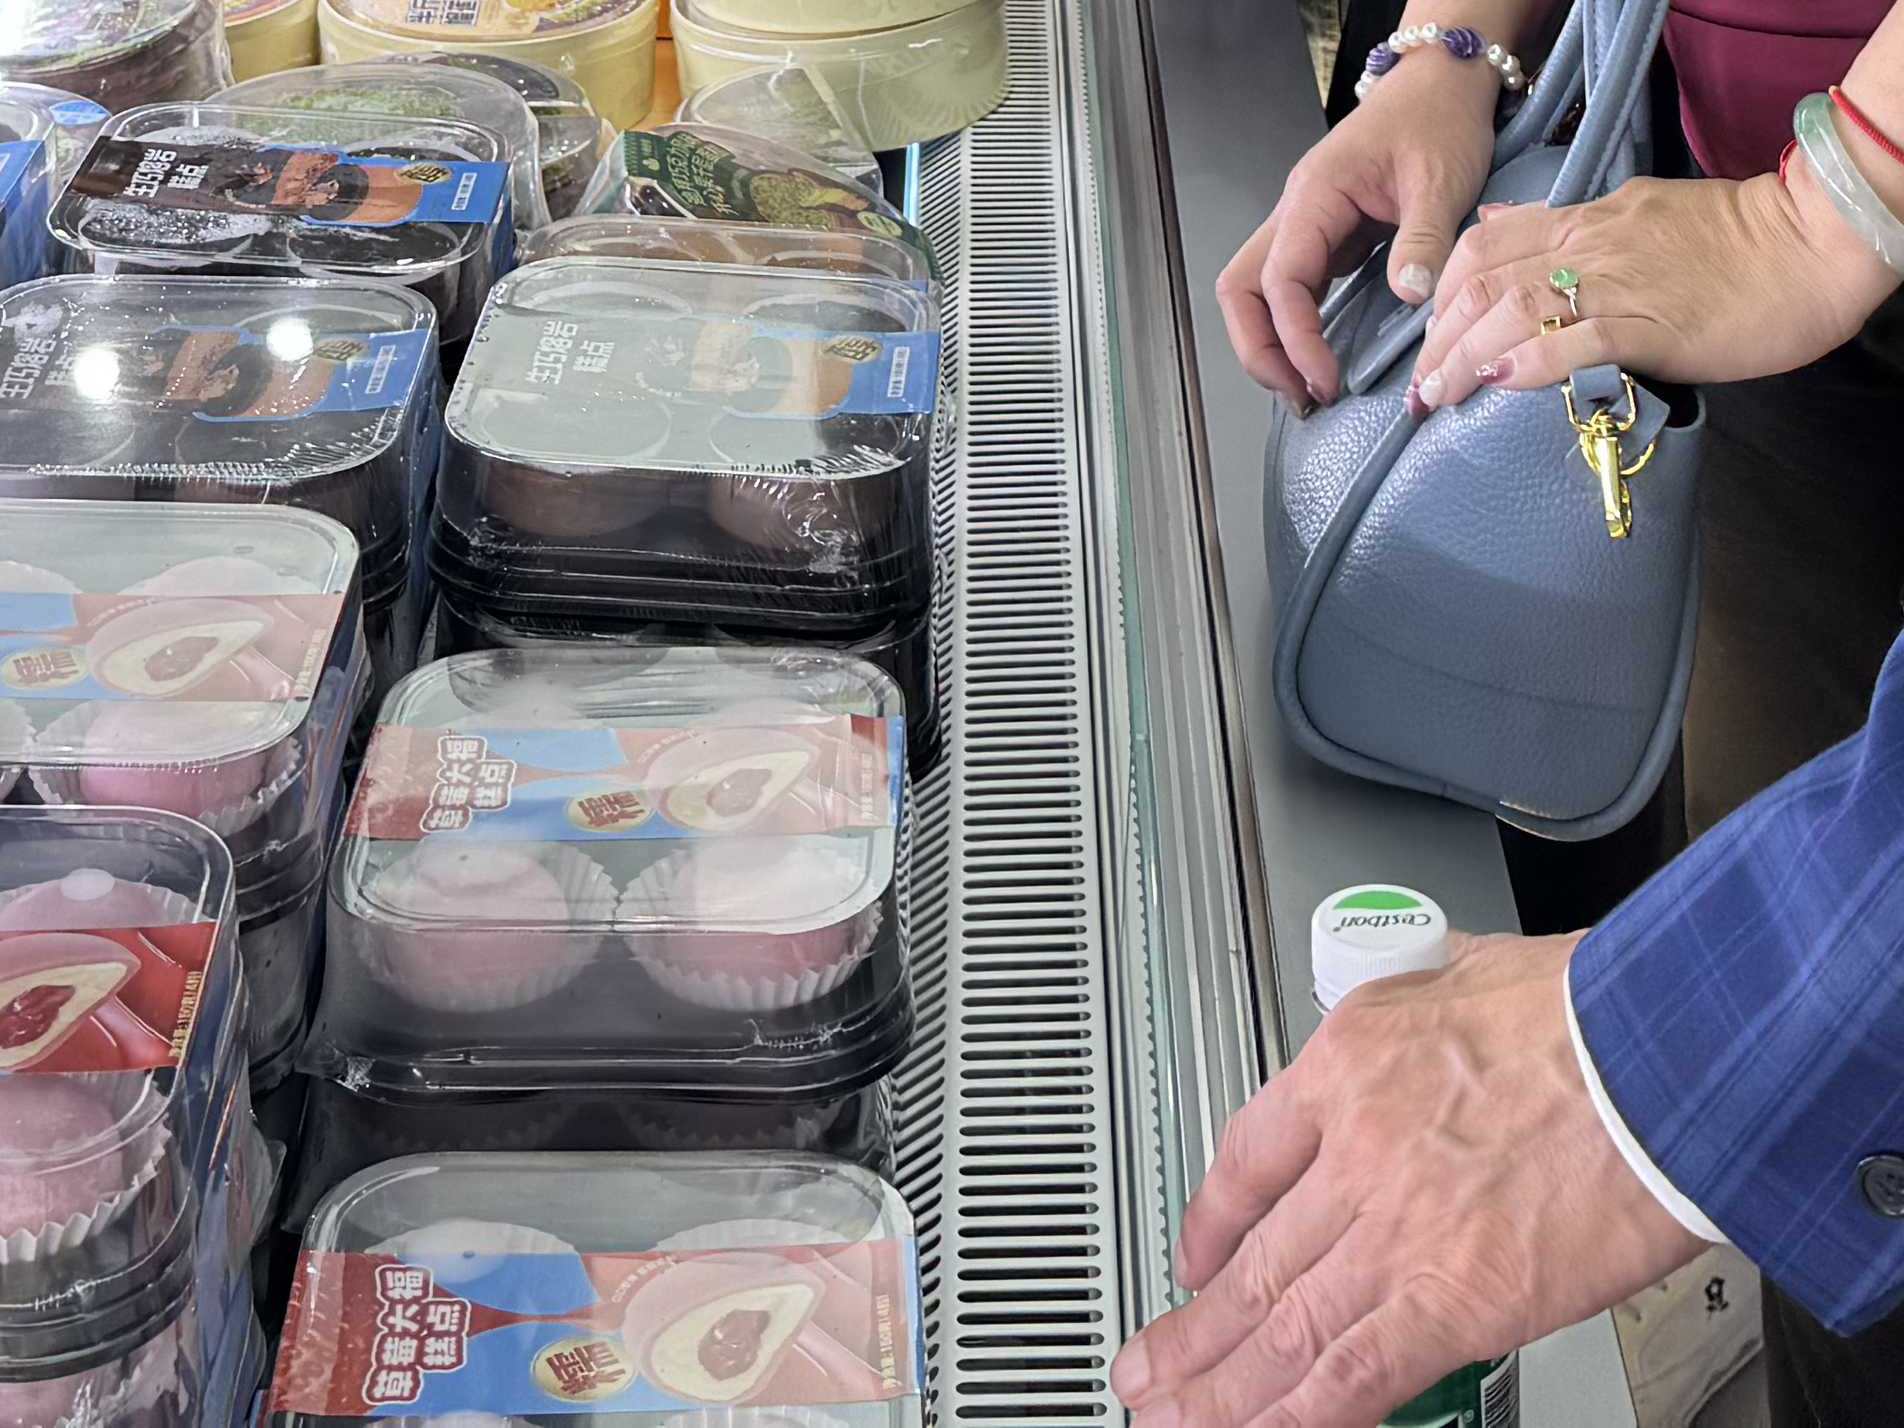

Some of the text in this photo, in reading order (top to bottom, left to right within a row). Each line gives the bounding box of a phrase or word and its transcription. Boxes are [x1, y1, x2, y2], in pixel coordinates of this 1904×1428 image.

[372, 1269, 427, 1399] 草莓大福
[423, 1304, 468, 1368] 糕点
